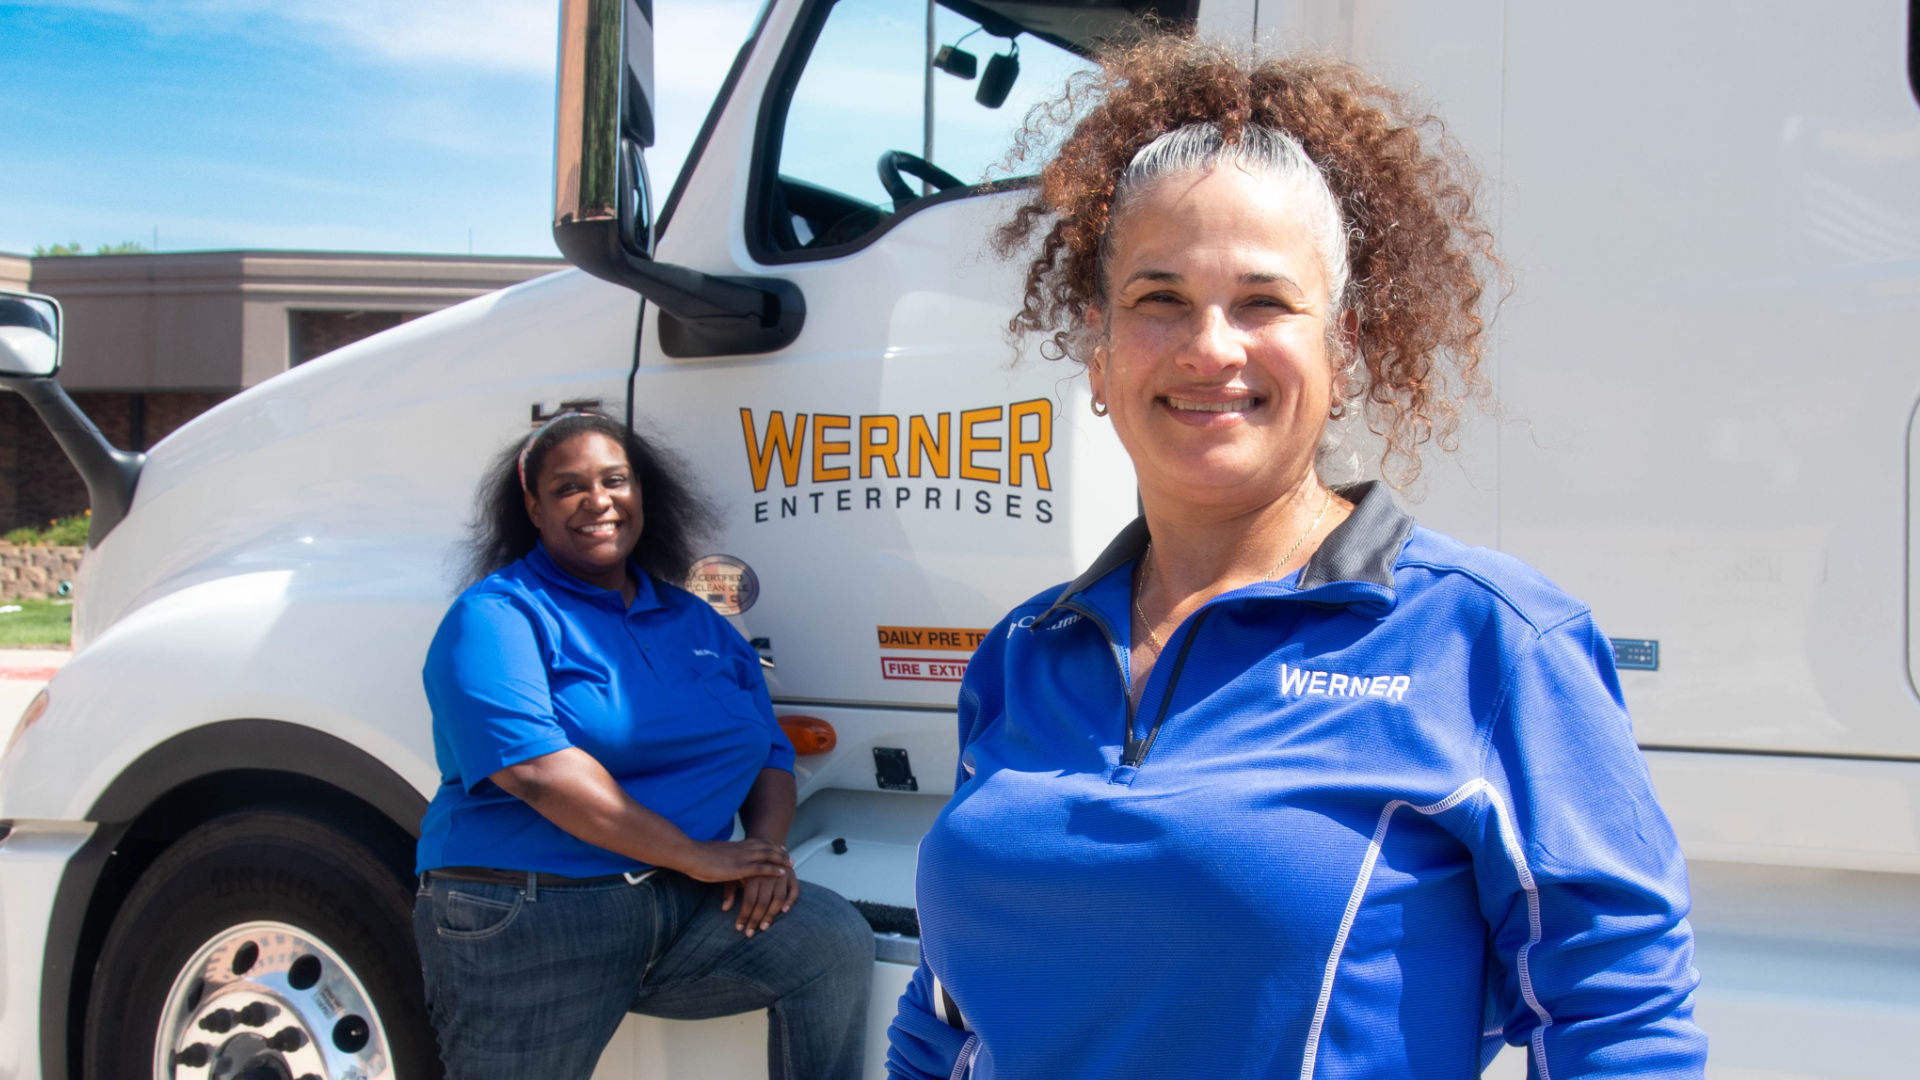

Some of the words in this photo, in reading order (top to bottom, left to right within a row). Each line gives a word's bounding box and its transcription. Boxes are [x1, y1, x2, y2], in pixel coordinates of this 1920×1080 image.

[739, 397, 1053, 493] WERNER
[754, 487, 1054, 524] ENTERPRISES
[698, 573, 743, 583] CERTIFIED
[694, 582, 726, 592] CLEAN
[877, 630, 923, 646] DAILY
[927, 632, 962, 647] PRE
[965, 632, 986, 647] TR
[888, 663, 920, 675] FIRE
[1280, 663, 1411, 701] WERNER
